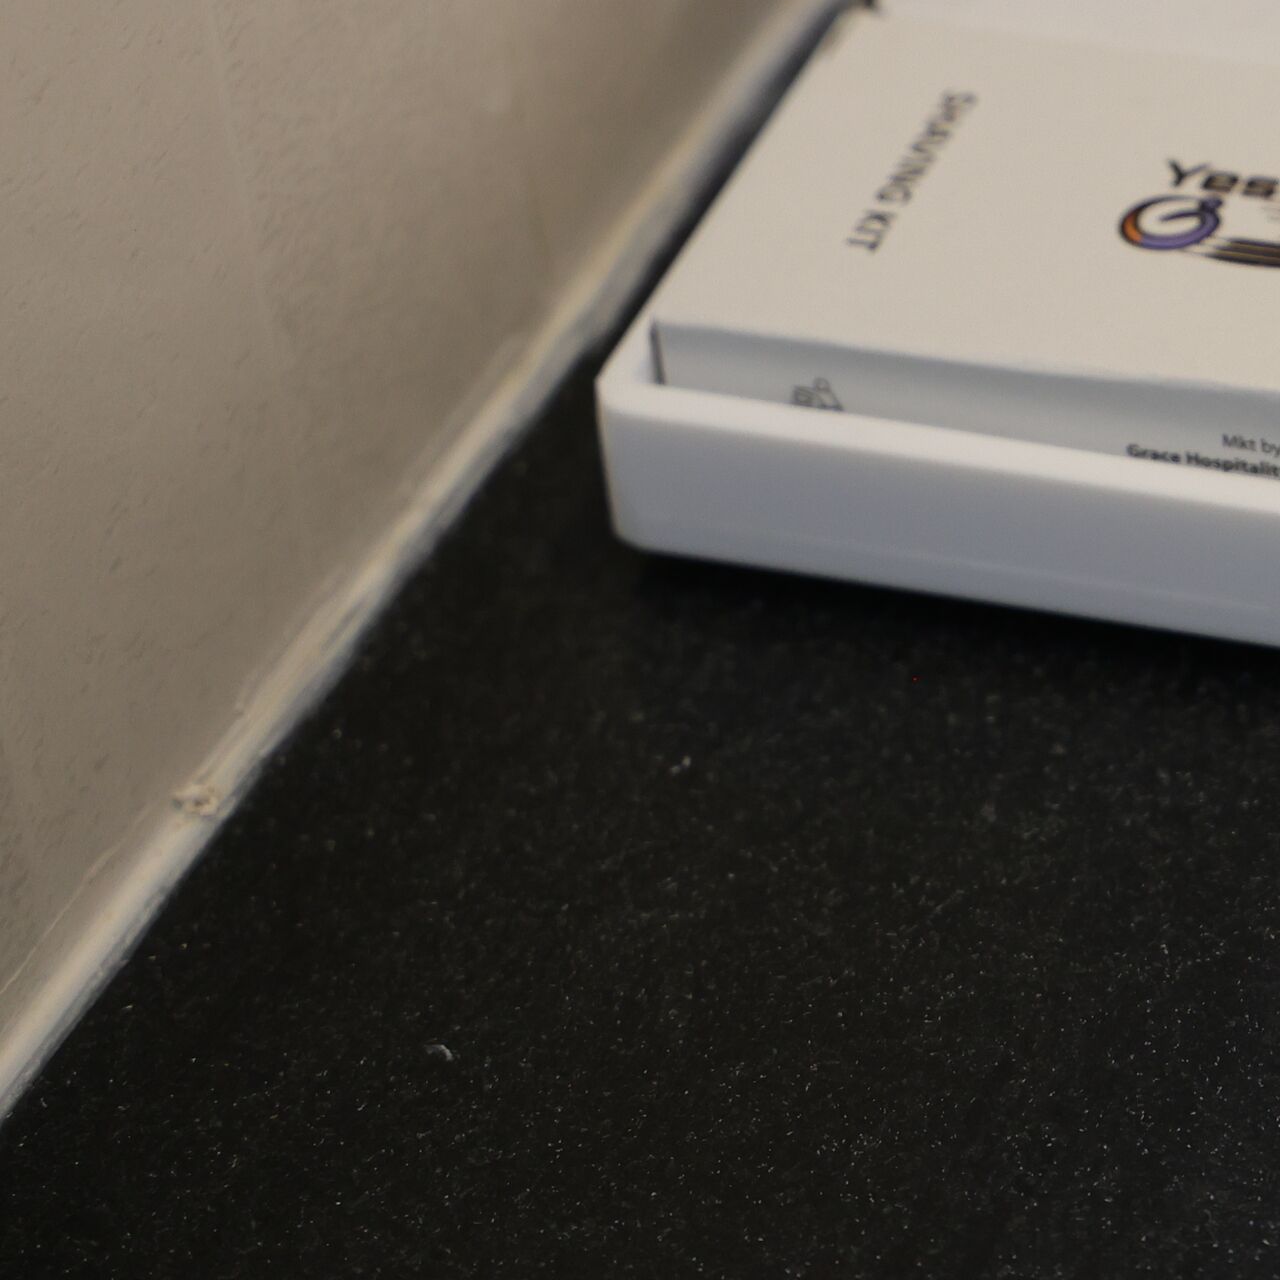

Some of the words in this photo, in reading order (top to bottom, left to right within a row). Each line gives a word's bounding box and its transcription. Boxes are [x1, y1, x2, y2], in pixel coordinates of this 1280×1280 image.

[875, 90, 979, 205] SHAVING
[1167, 157, 1280, 199] Yes
[846, 208, 898, 256] KIT
[1125, 442, 1182, 464] Grace
[1221, 433, 1257, 452] Mkt
